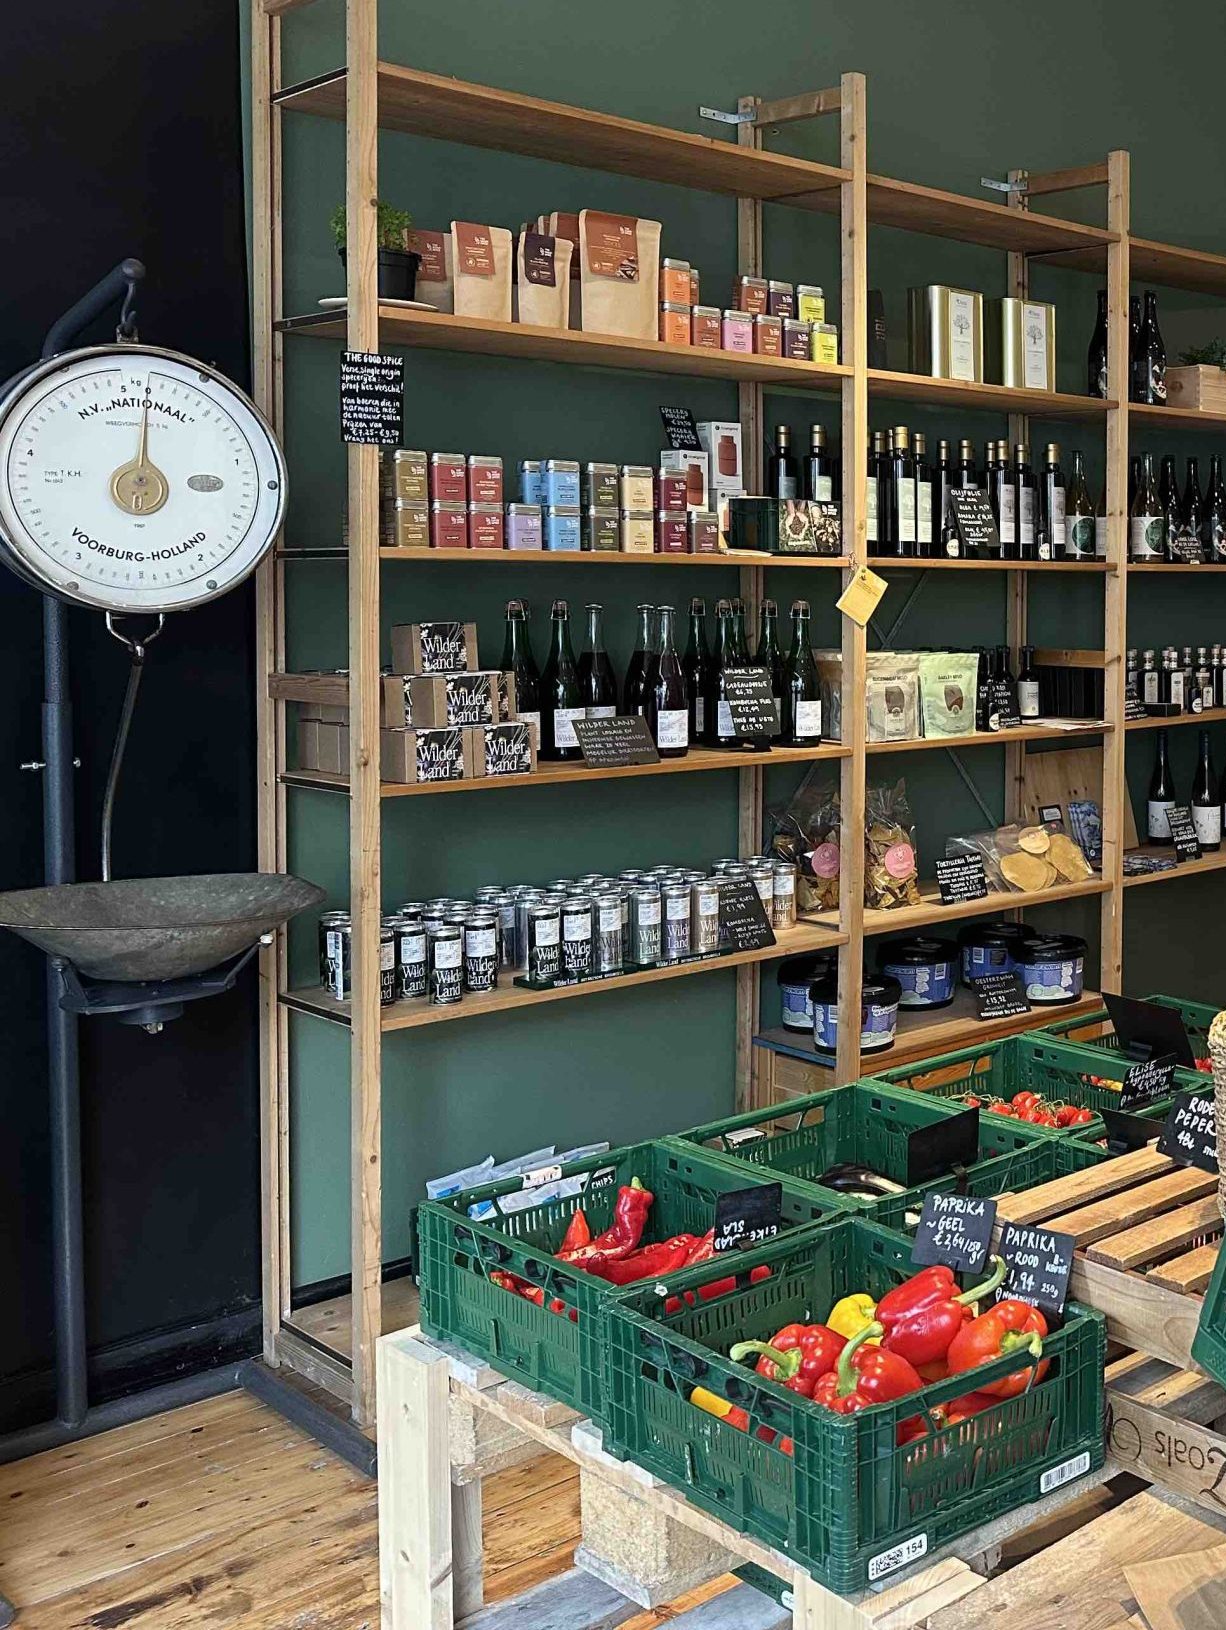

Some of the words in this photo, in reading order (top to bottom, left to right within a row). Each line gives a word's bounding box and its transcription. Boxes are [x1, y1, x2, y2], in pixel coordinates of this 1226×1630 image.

[344, 352, 362, 363] THE
[363, 355, 381, 364] GOOD
[382, 356, 403, 366] SPICE
[381, 369, 401, 380] origin
[120, 385, 127, 393] 5
[343, 404, 381, 413] harmonie
[356, 397, 380, 406] boeren
[380, 399, 392, 407] die
[27, 449, 34, 457] 4
[71, 527, 207, 562] VOORBURG-HOLLAND
[75, 552, 82, 560] 3
[197, 554, 204, 562] 2
[423, 637, 461, 653] Wilder
[423, 656, 454, 670] Land
[448, 690, 487, 705] Wilder
[448, 708, 479, 723] Land
[577, 720, 611, 729] WILDER
[612, 719, 636, 728] LAND
[419, 745, 458, 761] Wilder
[487, 740, 525, 756] Wilder
[418, 764, 450, 779] Land
[487, 757, 517, 772] Land
[402, 978, 425, 992] Land
[436, 983, 461, 997] Land
[1189, 1097, 1216, 1116] RODE
[933, 1194, 985, 1217] PAPRIKA
[723, 1220, 745, 1235] SLA
[937, 1215, 966, 1232] GEEL
[1005, 1226, 1056, 1253] PAPRIKA
[1014, 1251, 1039, 1268] ROOD
[1040, 1282, 1059, 1298] 250g
[906, 1539, 923, 1555] 154
